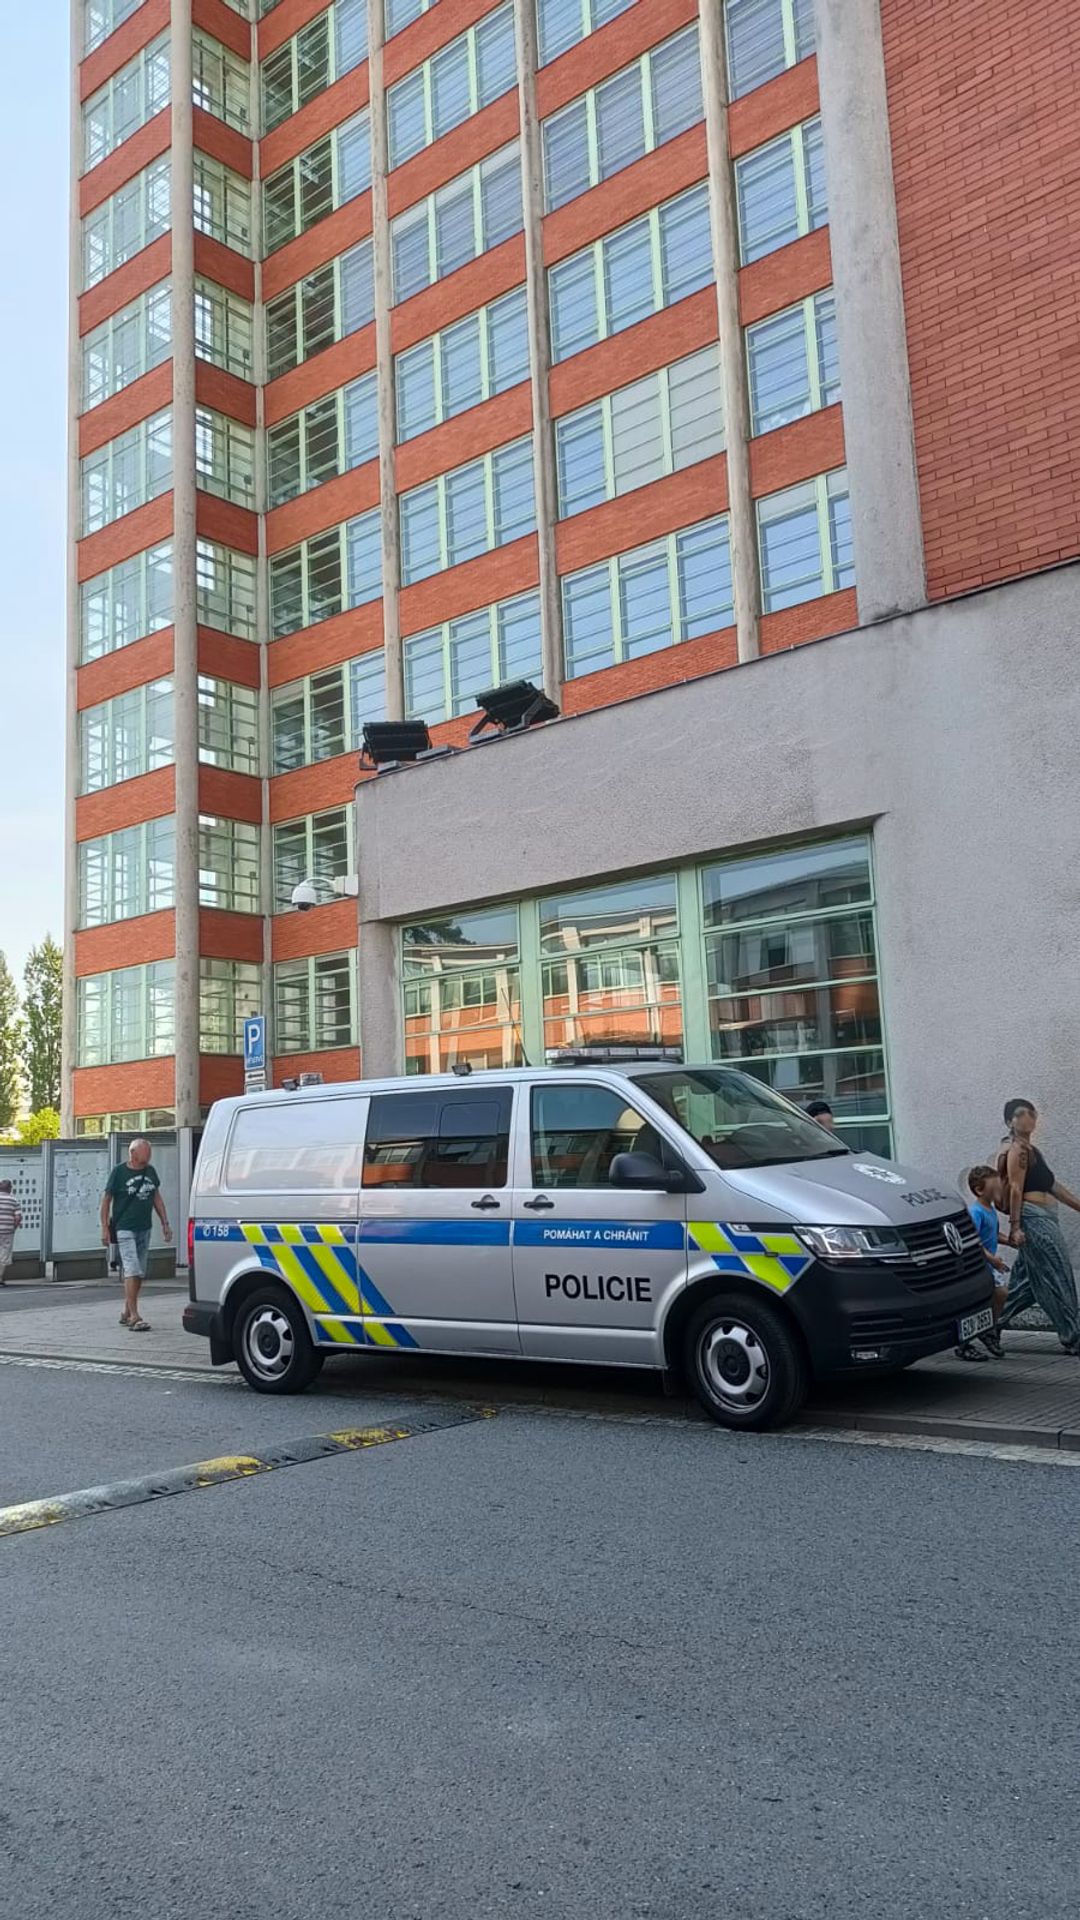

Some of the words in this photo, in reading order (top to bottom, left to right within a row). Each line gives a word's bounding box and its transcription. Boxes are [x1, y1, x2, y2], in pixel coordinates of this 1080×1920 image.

[248, 1024, 261, 1054] P
[212, 1225, 230, 1238] 158
[543, 1227, 592, 1240] POMÁHAT
[594, 1230, 602, 1240] A
[603, 1228, 649, 1242] CHRÁNIT
[545, 1274, 652, 1302] POLICIE
